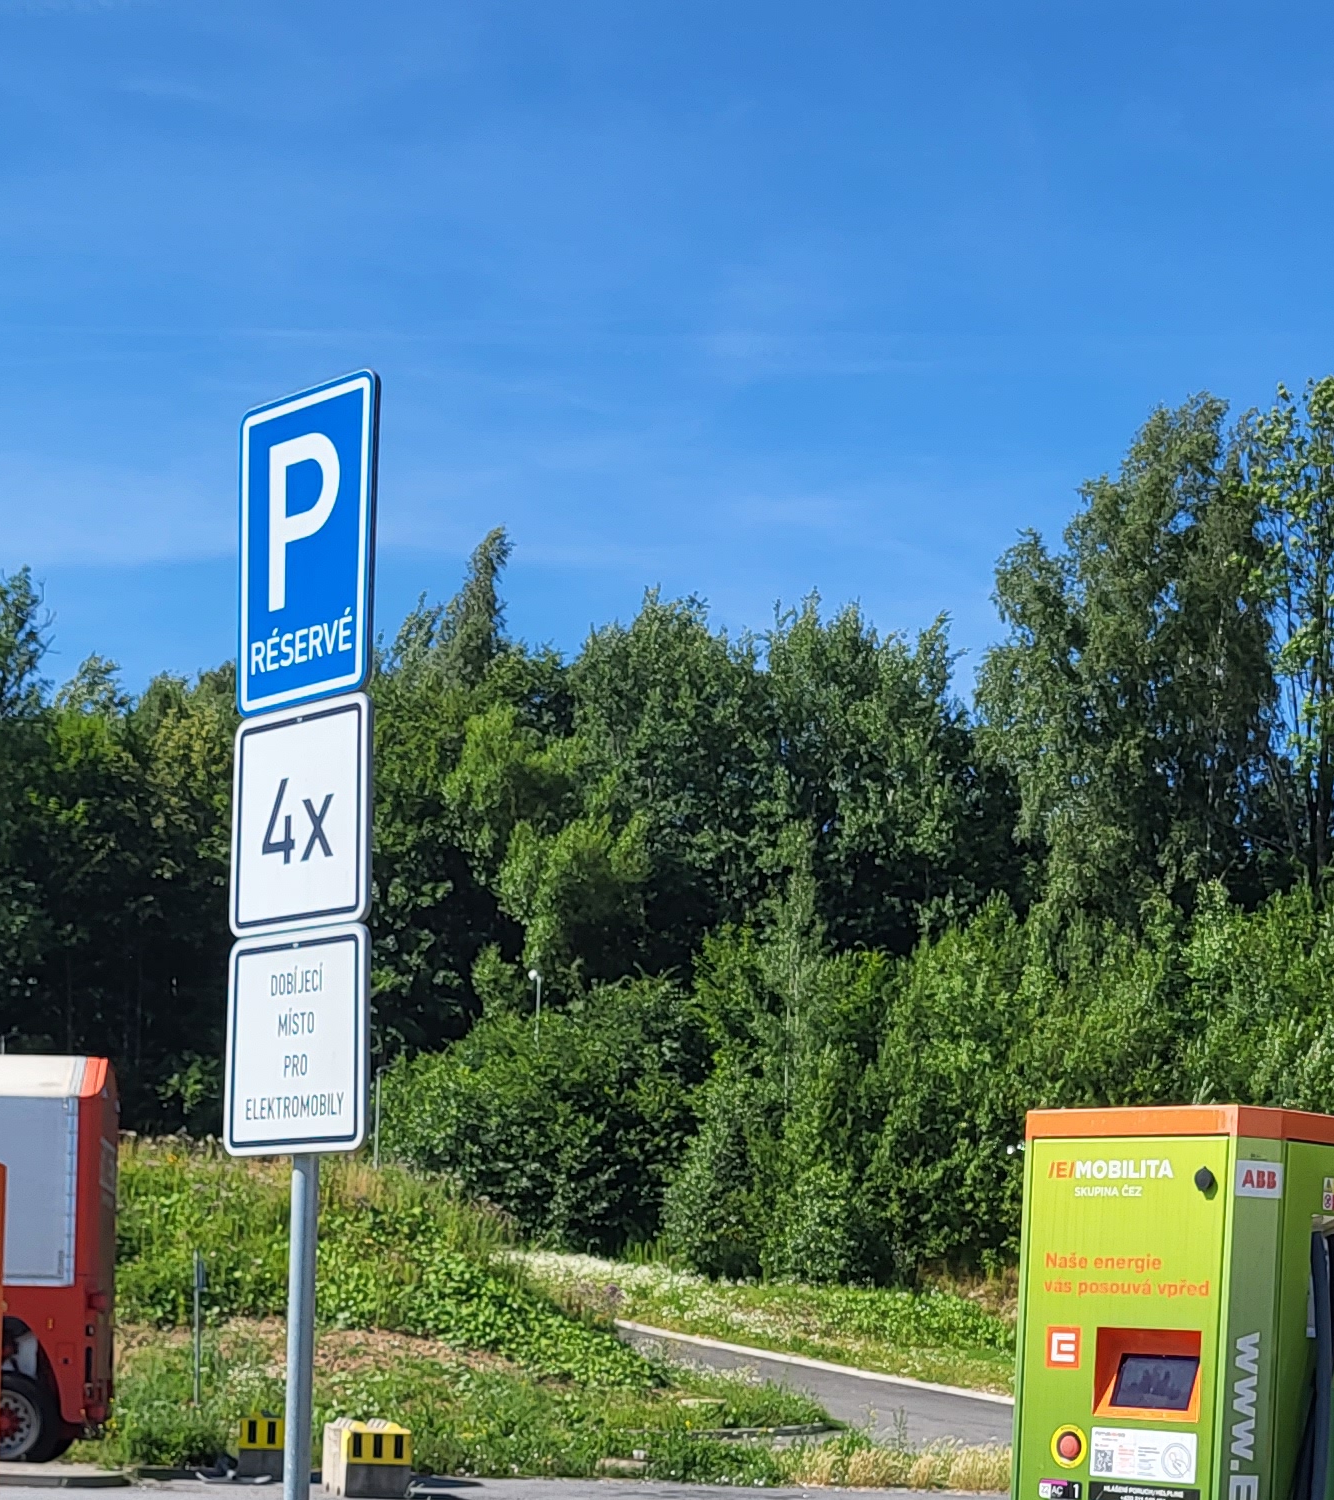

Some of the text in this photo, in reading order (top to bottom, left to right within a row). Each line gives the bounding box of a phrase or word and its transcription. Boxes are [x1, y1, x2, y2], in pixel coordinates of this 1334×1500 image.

[268, 432, 341, 612] P
[251, 606, 353, 675] RÉSERVÉ
[270, 962, 323, 996] DOBÍJECÍ
[278, 1008, 315, 1037] MÍSTO
[283, 1053, 308, 1078] PRO
[245, 1092, 344, 1121] ELEKTROMOBILY
[1074, 1183, 1143, 1197] SKUPINA ČEZ
[1242, 1169, 1277, 1189] ABB
[1045, 1252, 1162, 1273] Naše energie
[1044, 1277, 1210, 1298] vás posouvá vpřed
[1051, 1485, 1064, 1495] AC
[1073, 1483, 1079, 1499] 1
